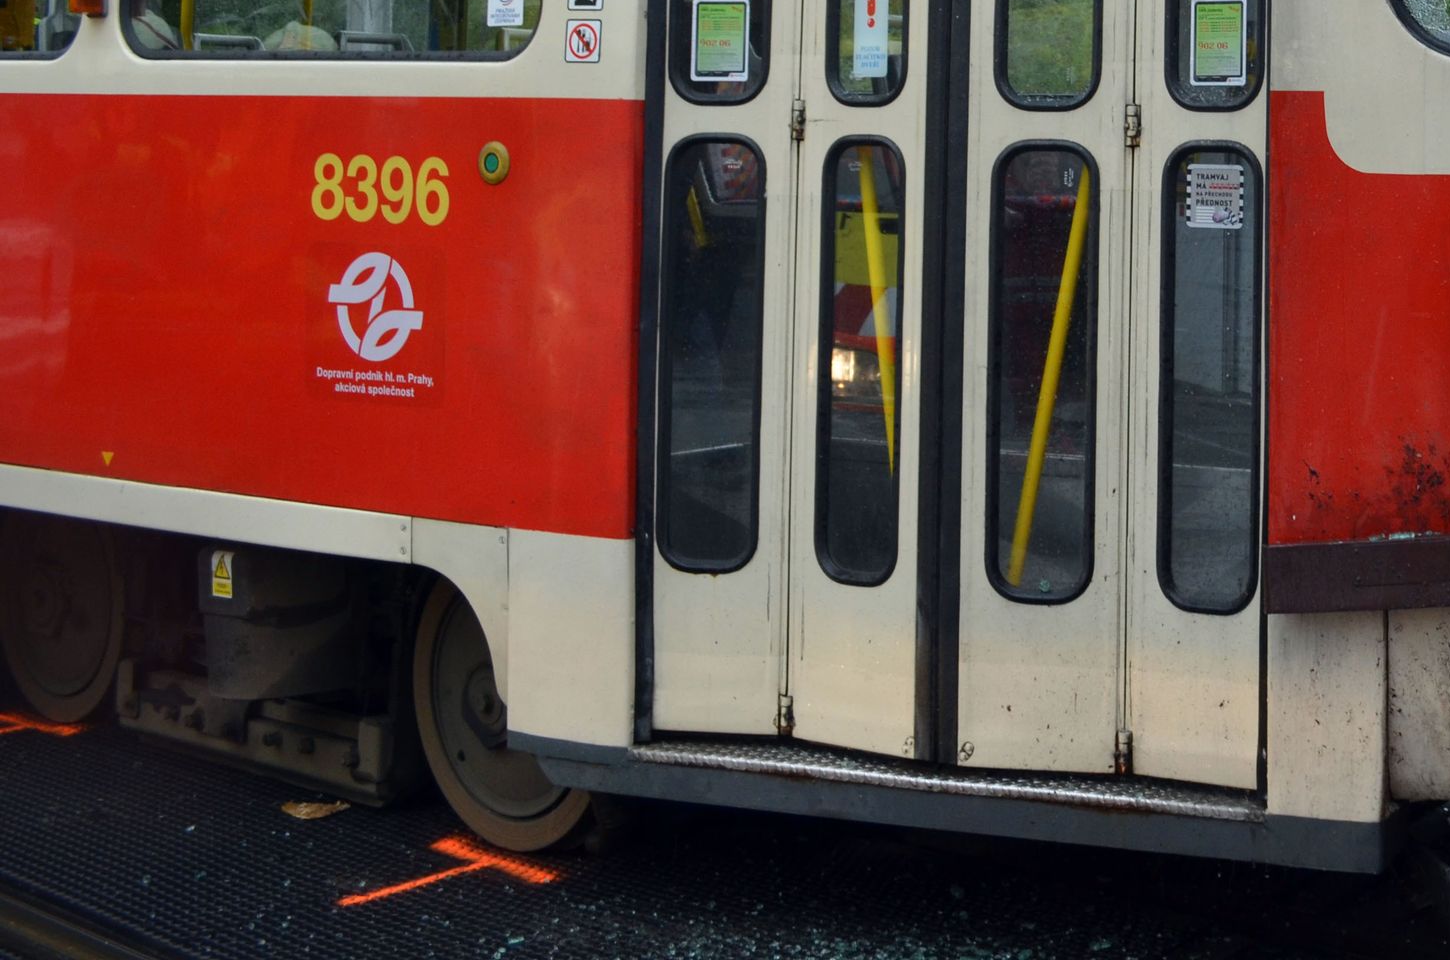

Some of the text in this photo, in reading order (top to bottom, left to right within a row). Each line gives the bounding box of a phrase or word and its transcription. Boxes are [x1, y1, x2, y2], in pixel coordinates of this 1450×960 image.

[1196, 173, 1229, 181] TRAMVAJ
[311, 152, 450, 227] 8396
[1196, 180, 1206, 189] MÁ
[1196, 197, 1233, 207] PŘEDNOST
[316, 367, 354, 380] Dopravní
[355, 370, 383, 382] podnik
[335, 383, 414, 397] akciová společnost
